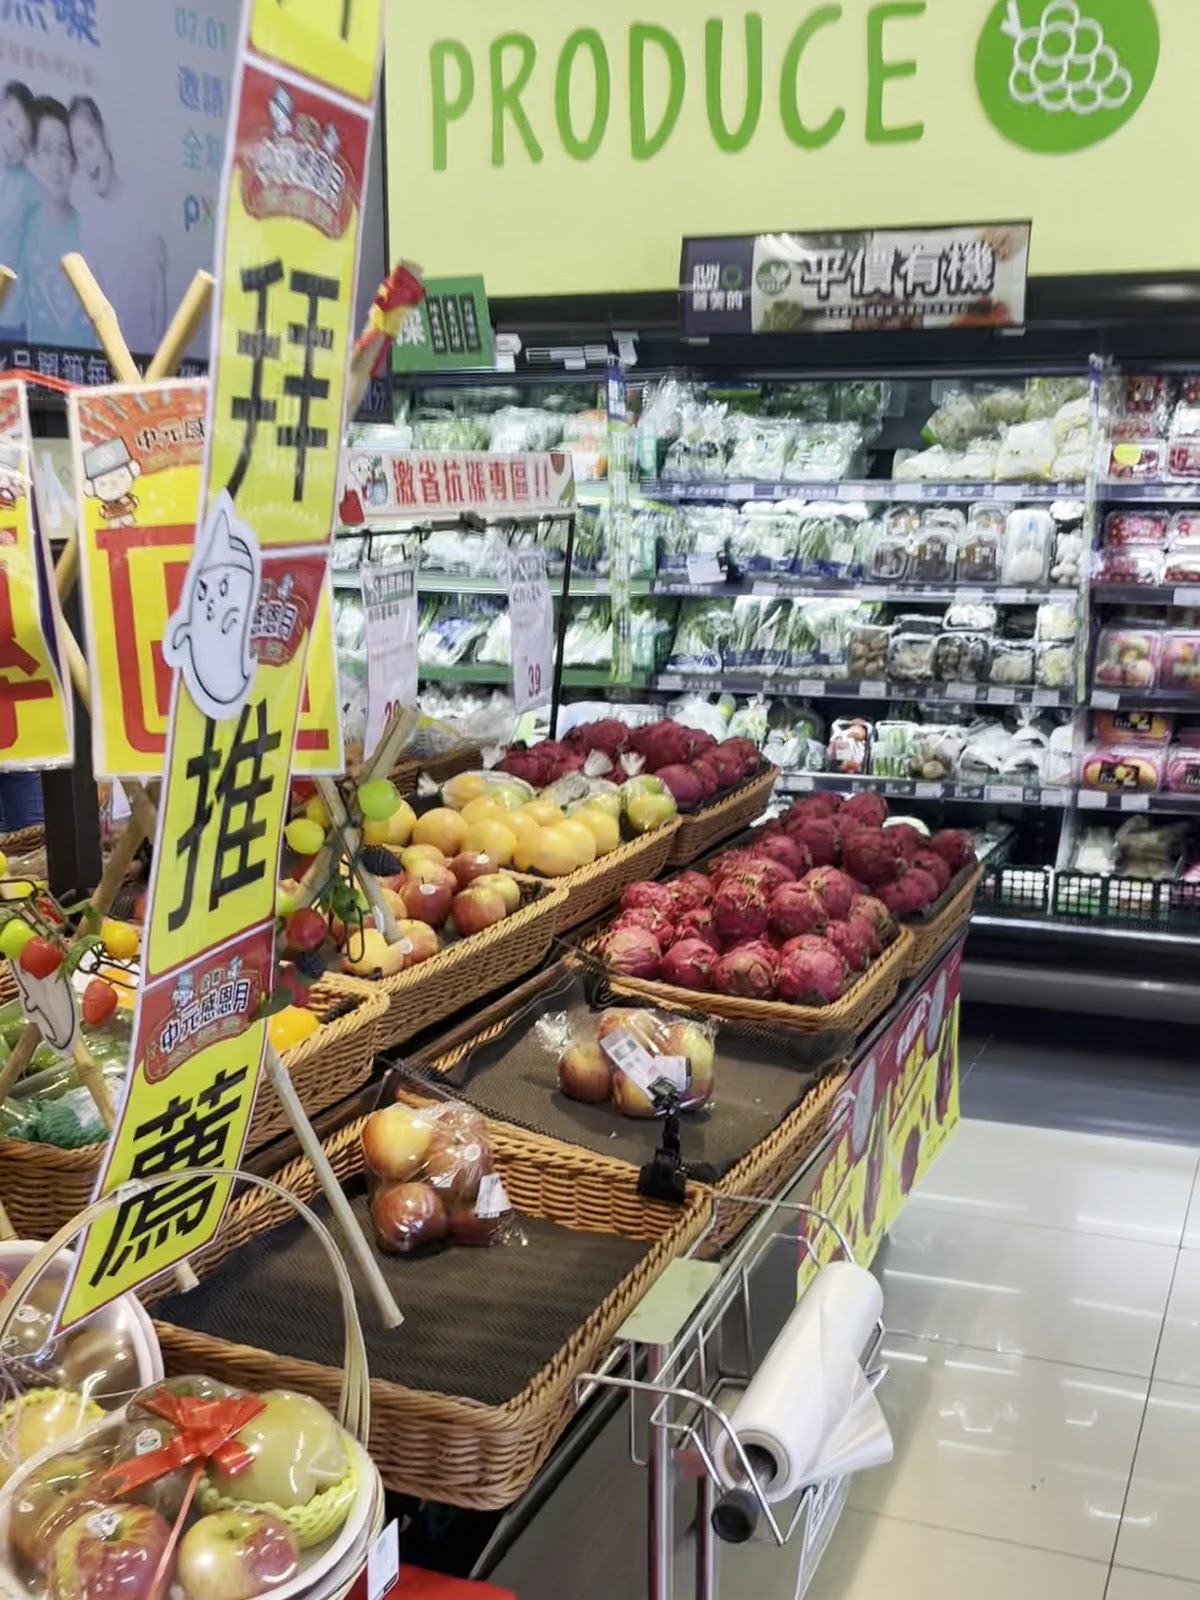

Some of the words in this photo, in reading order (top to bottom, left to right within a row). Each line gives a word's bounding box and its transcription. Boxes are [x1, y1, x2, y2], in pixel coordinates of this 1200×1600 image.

[430, 2, 926, 171] PRODUCE
[801, 241, 996, 301] 平價有機
[527, 664, 542, 698] 39
[160, 979, 251, 1054] 中元感恩月
